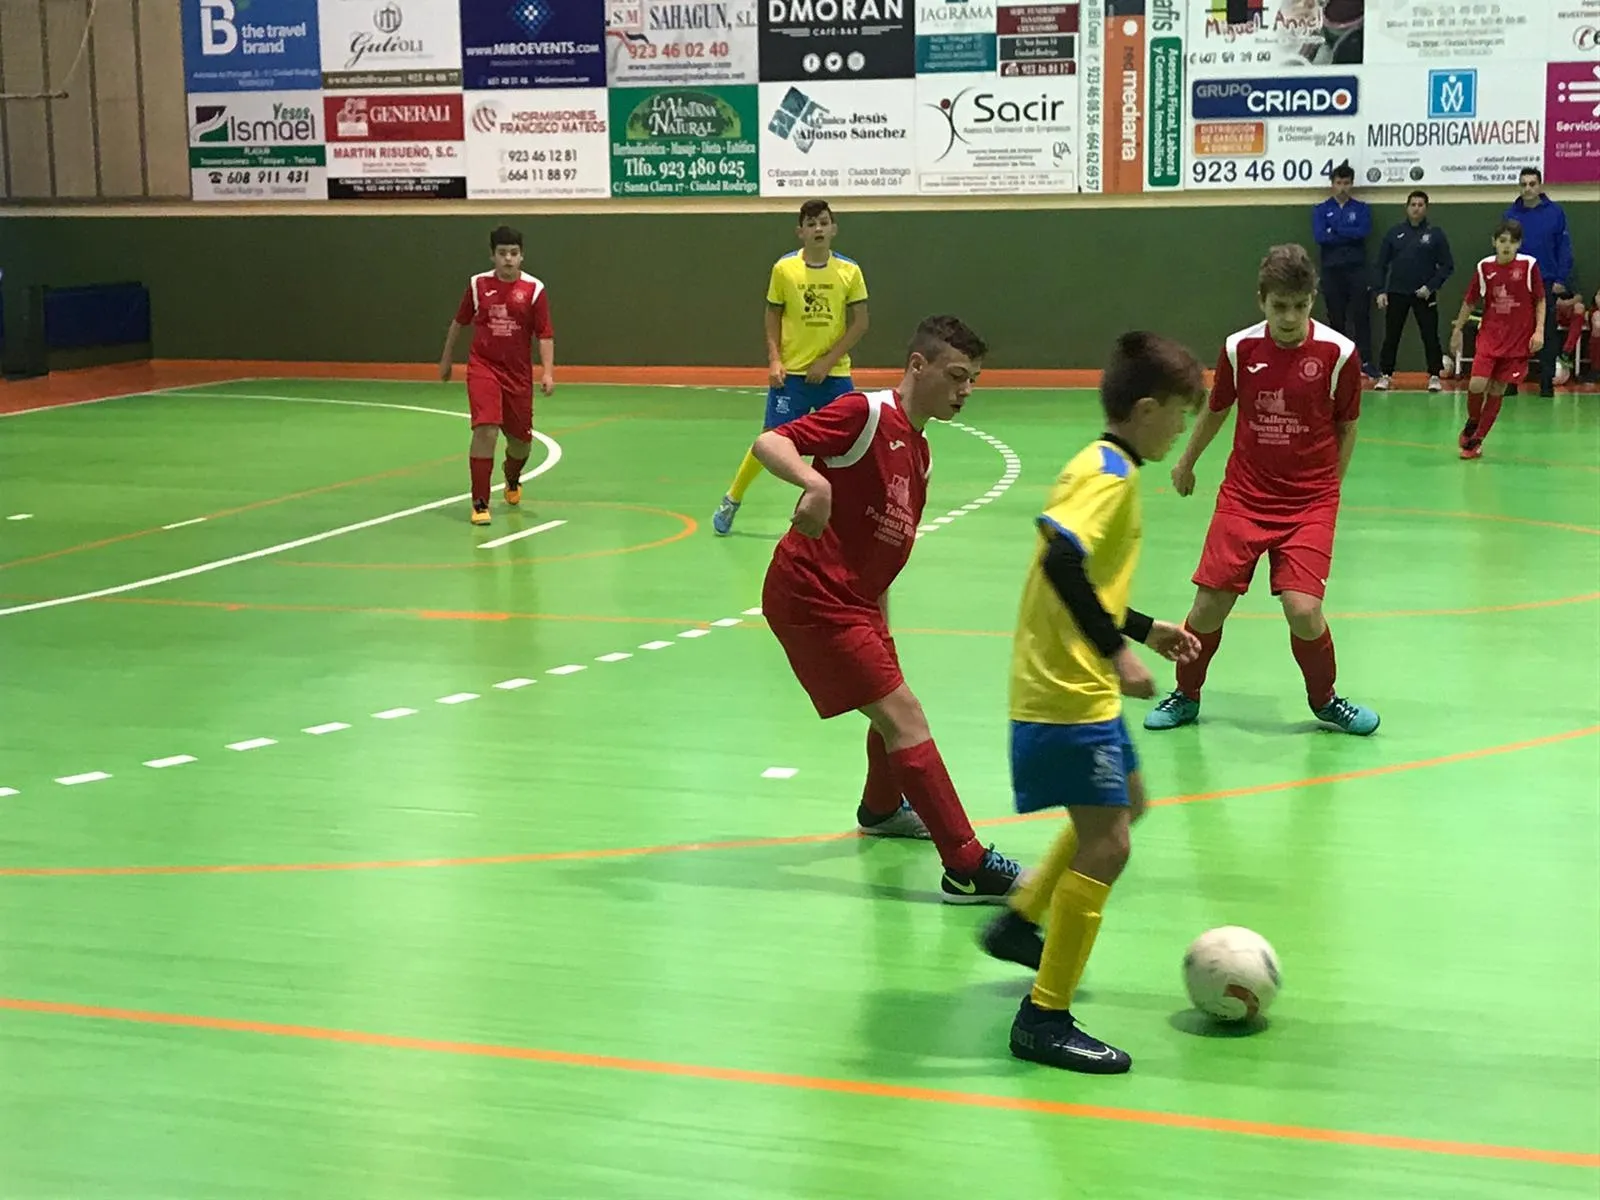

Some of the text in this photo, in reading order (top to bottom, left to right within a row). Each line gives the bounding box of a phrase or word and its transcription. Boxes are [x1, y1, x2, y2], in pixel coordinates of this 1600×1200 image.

[768, 0, 903, 22] DMORAN
[920, 7, 993, 23] JAGRAMA
[242, 22, 306, 38] the travel
[1205, 12, 1260, 43] Miguel
[243, 39, 285, 54] brand
[631, 41, 729, 59] 923 46 02 40
[1087, 67, 1100, 85] 923
[1196, 84, 1352, 112] GRUPO CRIADO
[273, 102, 310, 120] Yesos
[370, 105, 450, 122] GENERALI
[512, 110, 597, 121] HORMIGONES
[973, 93, 1064, 122] Sacir
[849, 112, 888, 125] Jesús
[231, 113, 316, 141] Ismael
[500, 121, 606, 133] FRANCISCO MATEOS
[799, 127, 906, 140] Alfonso Sánchez
[1278, 125, 1313, 134] Entrega
[1367, 120, 1540, 147] MIROBRIGAWAGEN
[1086, 133, 1099, 151] 664
[1328, 131, 1355, 146] 24 h
[508, 149, 577, 162] 923 46 12 81
[508, 169, 577, 180] 664 11 88 97
[624, 156, 745, 179] Tlfo. 923 480 625
[1193, 160, 1237, 183] 923
[1245, 159, 1275, 181] 46
[1283, 159, 1312, 181] 00
[227, 170, 309, 184] 608 911 431
[624, 182, 649, 192] Santa
[650, 181, 673, 192] Clara
[690, 180, 721, 191] Ciudad
[723, 180, 757, 193] Rodrigo
